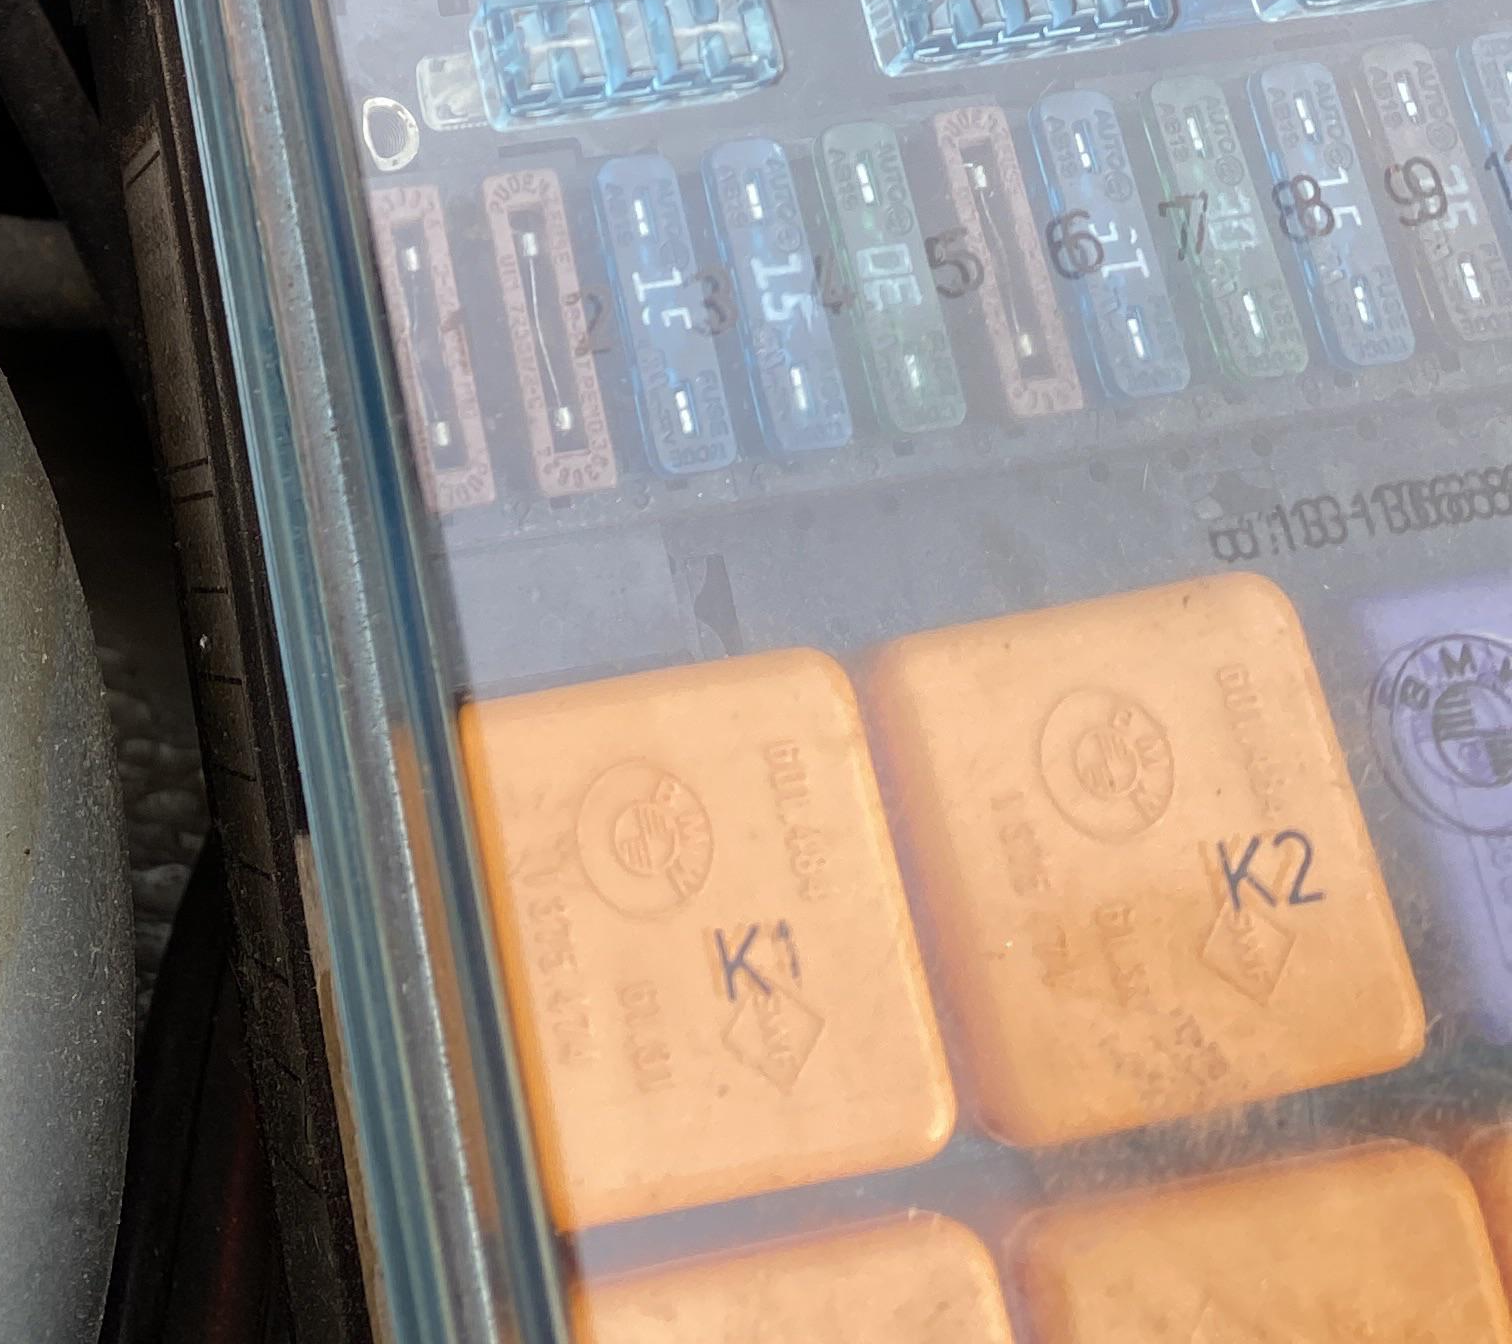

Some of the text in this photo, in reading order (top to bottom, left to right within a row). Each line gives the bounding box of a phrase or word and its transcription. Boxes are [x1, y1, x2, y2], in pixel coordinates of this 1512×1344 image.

[1158, 191, 1209, 262] 7
[1271, 172, 1335, 242] 8
[1384, 156, 1448, 228] 9
[1216, 827, 1328, 912] K2
[713, 920, 802, 1002] K1
